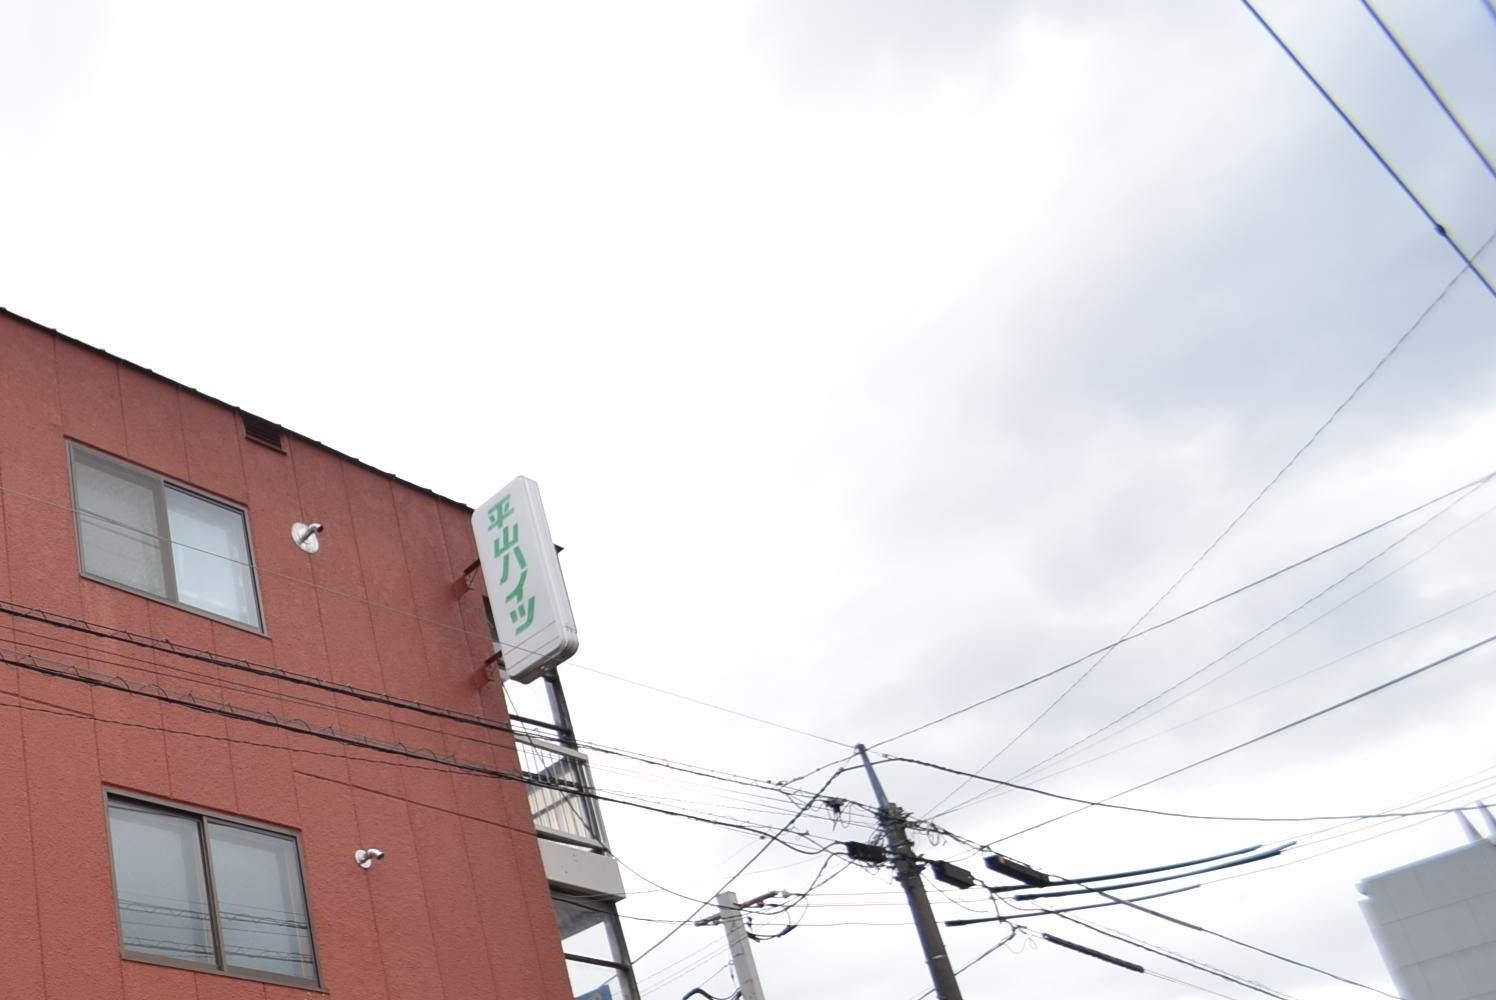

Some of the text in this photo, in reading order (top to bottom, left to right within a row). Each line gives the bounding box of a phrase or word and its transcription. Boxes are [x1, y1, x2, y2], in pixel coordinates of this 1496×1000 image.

[487, 495, 535, 636] 平山ハイツ
